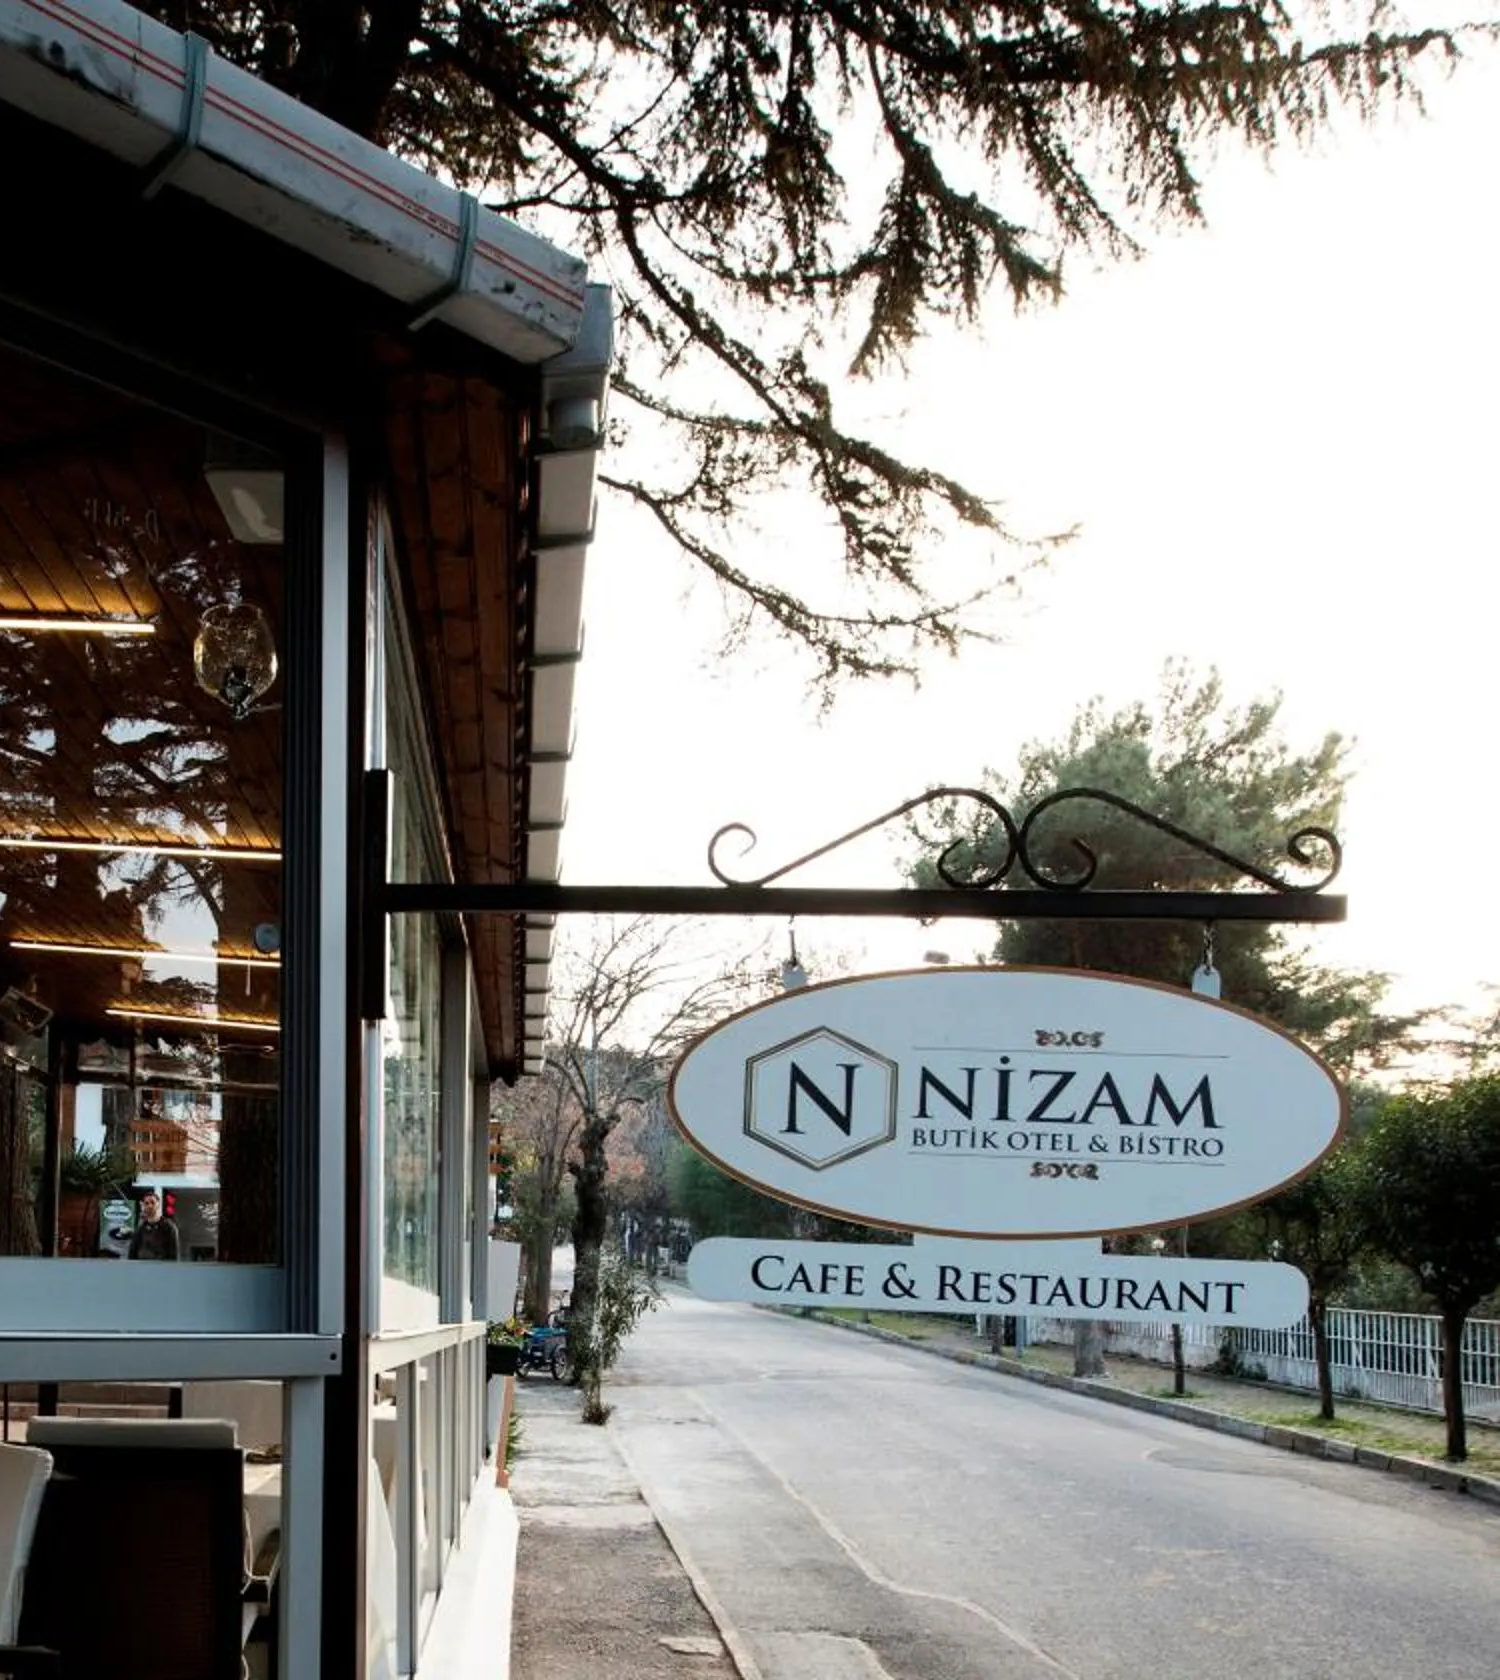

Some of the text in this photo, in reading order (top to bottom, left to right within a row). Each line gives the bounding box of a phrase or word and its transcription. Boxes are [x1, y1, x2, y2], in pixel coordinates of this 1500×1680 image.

[778, 1060, 861, 1138] N
[1006, 1131, 1079, 1152] OTEL
[1088, 1135, 1109, 1153] &
[750, 1255, 1246, 1314] CAFE & RESTAURANT
